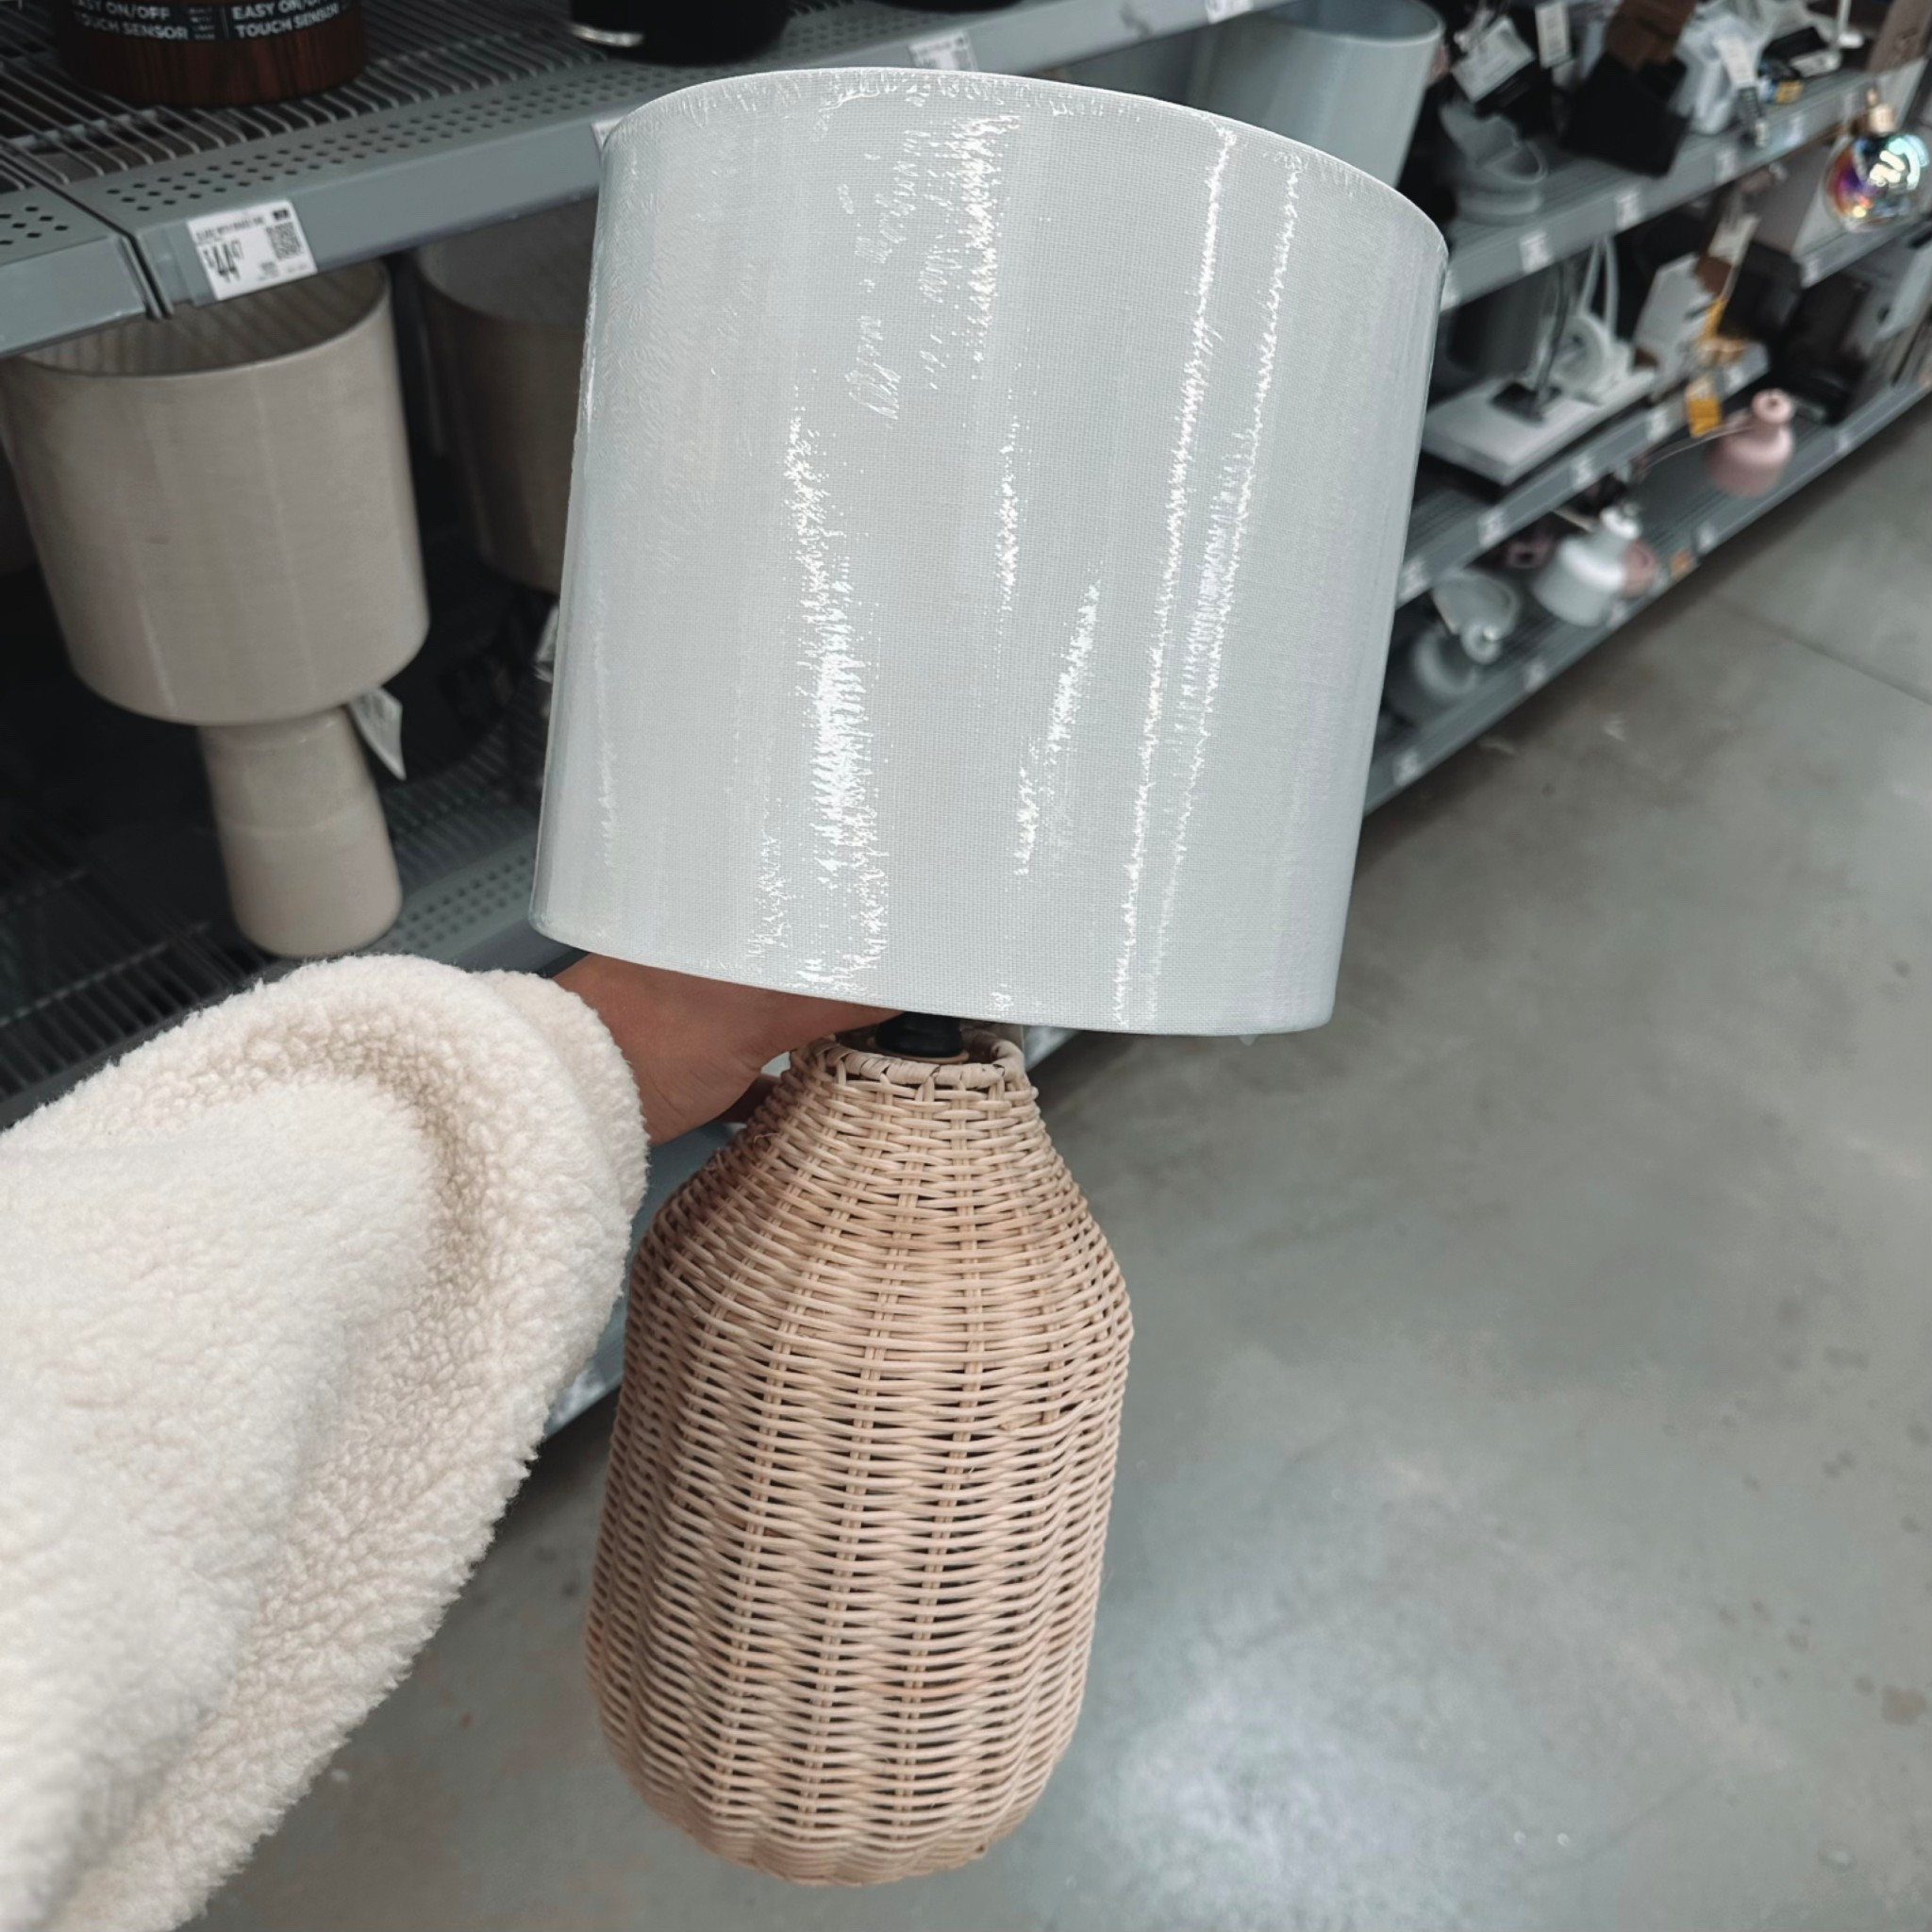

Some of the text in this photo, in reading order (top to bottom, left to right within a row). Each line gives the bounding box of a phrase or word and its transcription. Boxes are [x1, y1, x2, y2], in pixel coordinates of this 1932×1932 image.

[107, 2, 171, 20] ON/OFF
[231, 3, 275, 20] EASY
[75, 10, 120, 32] TOUCH
[121, 21, 189, 40] SENSOR
[234, 17, 292, 39] TOUCH
